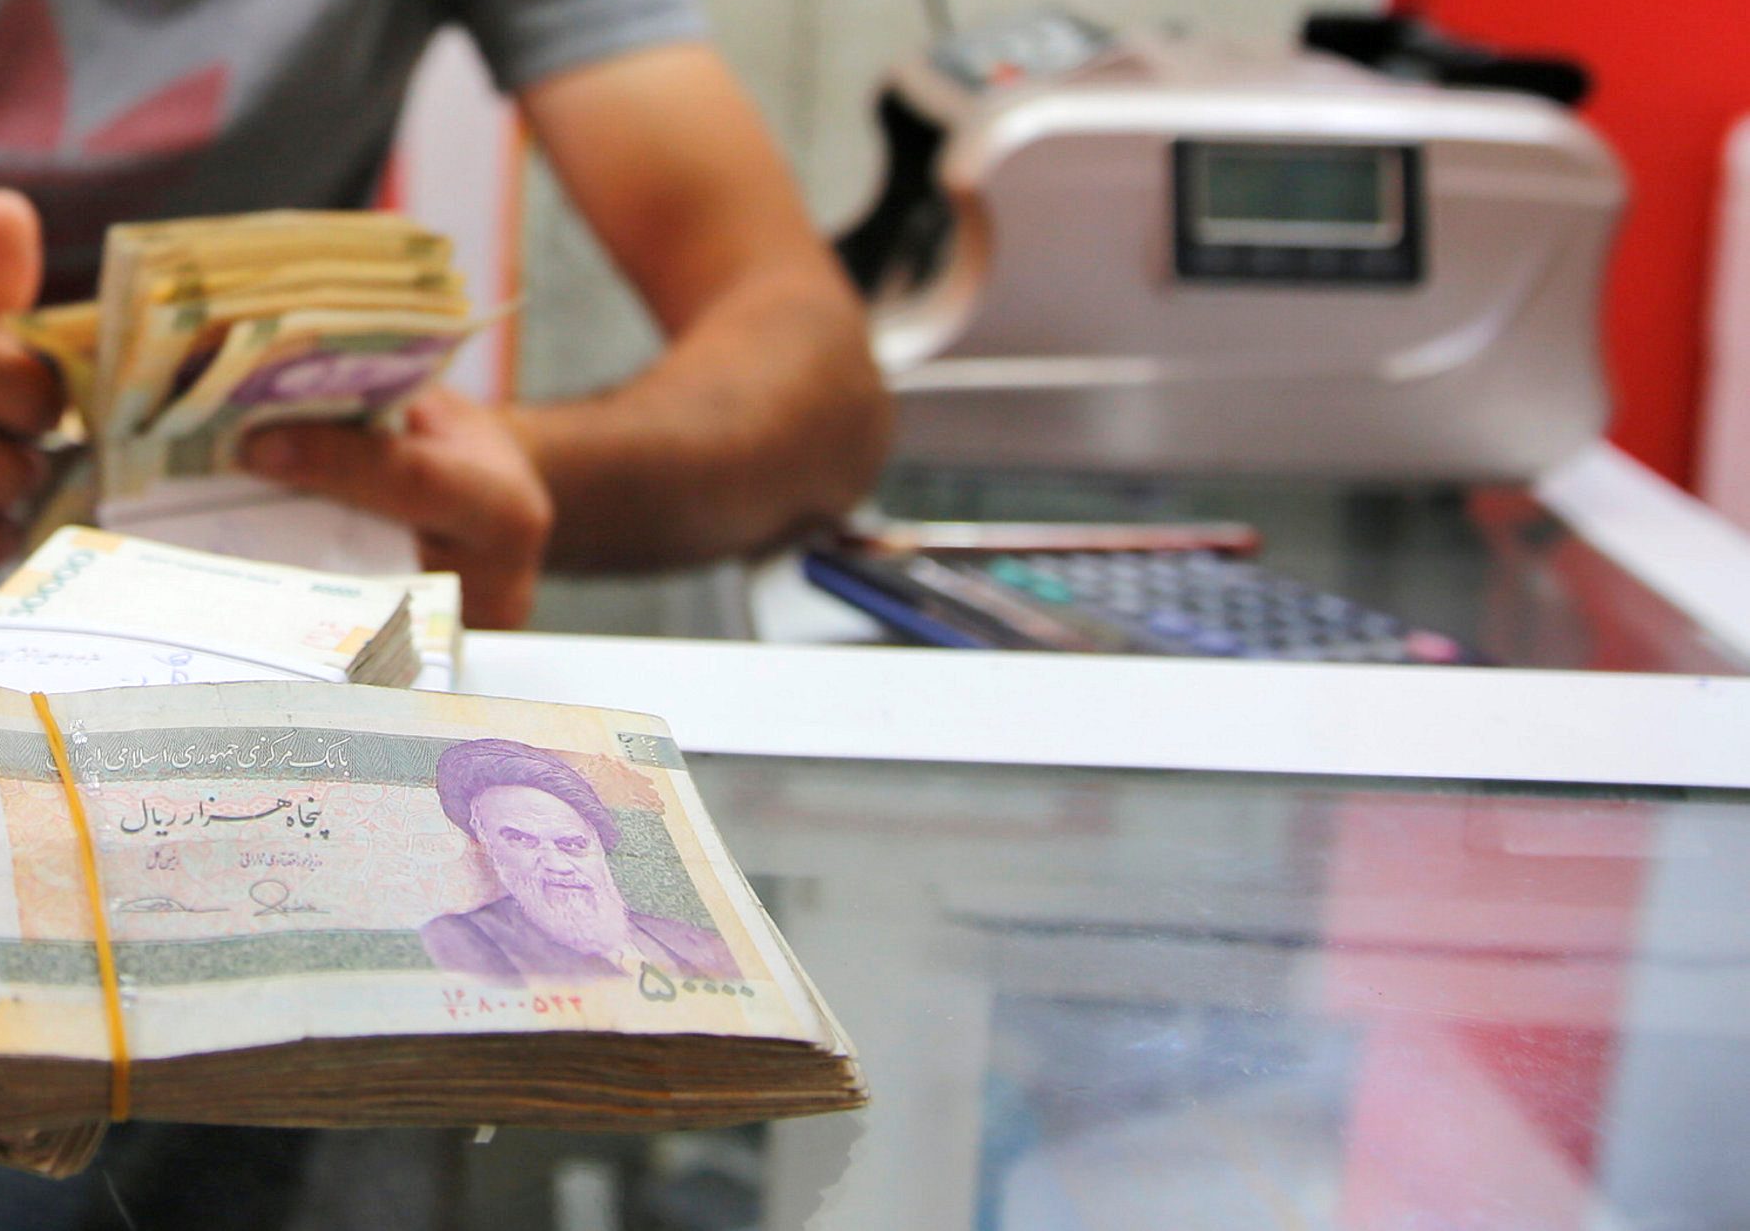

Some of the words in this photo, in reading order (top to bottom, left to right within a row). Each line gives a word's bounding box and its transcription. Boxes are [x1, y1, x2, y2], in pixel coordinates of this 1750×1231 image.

[103, 742, 171, 771] اسلامی
[170, 741, 240, 773] جمهوری
[119, 798, 178, 837] ریال
[182, 795, 293, 828] هزار
[286, 796, 332, 841] پنجاه
